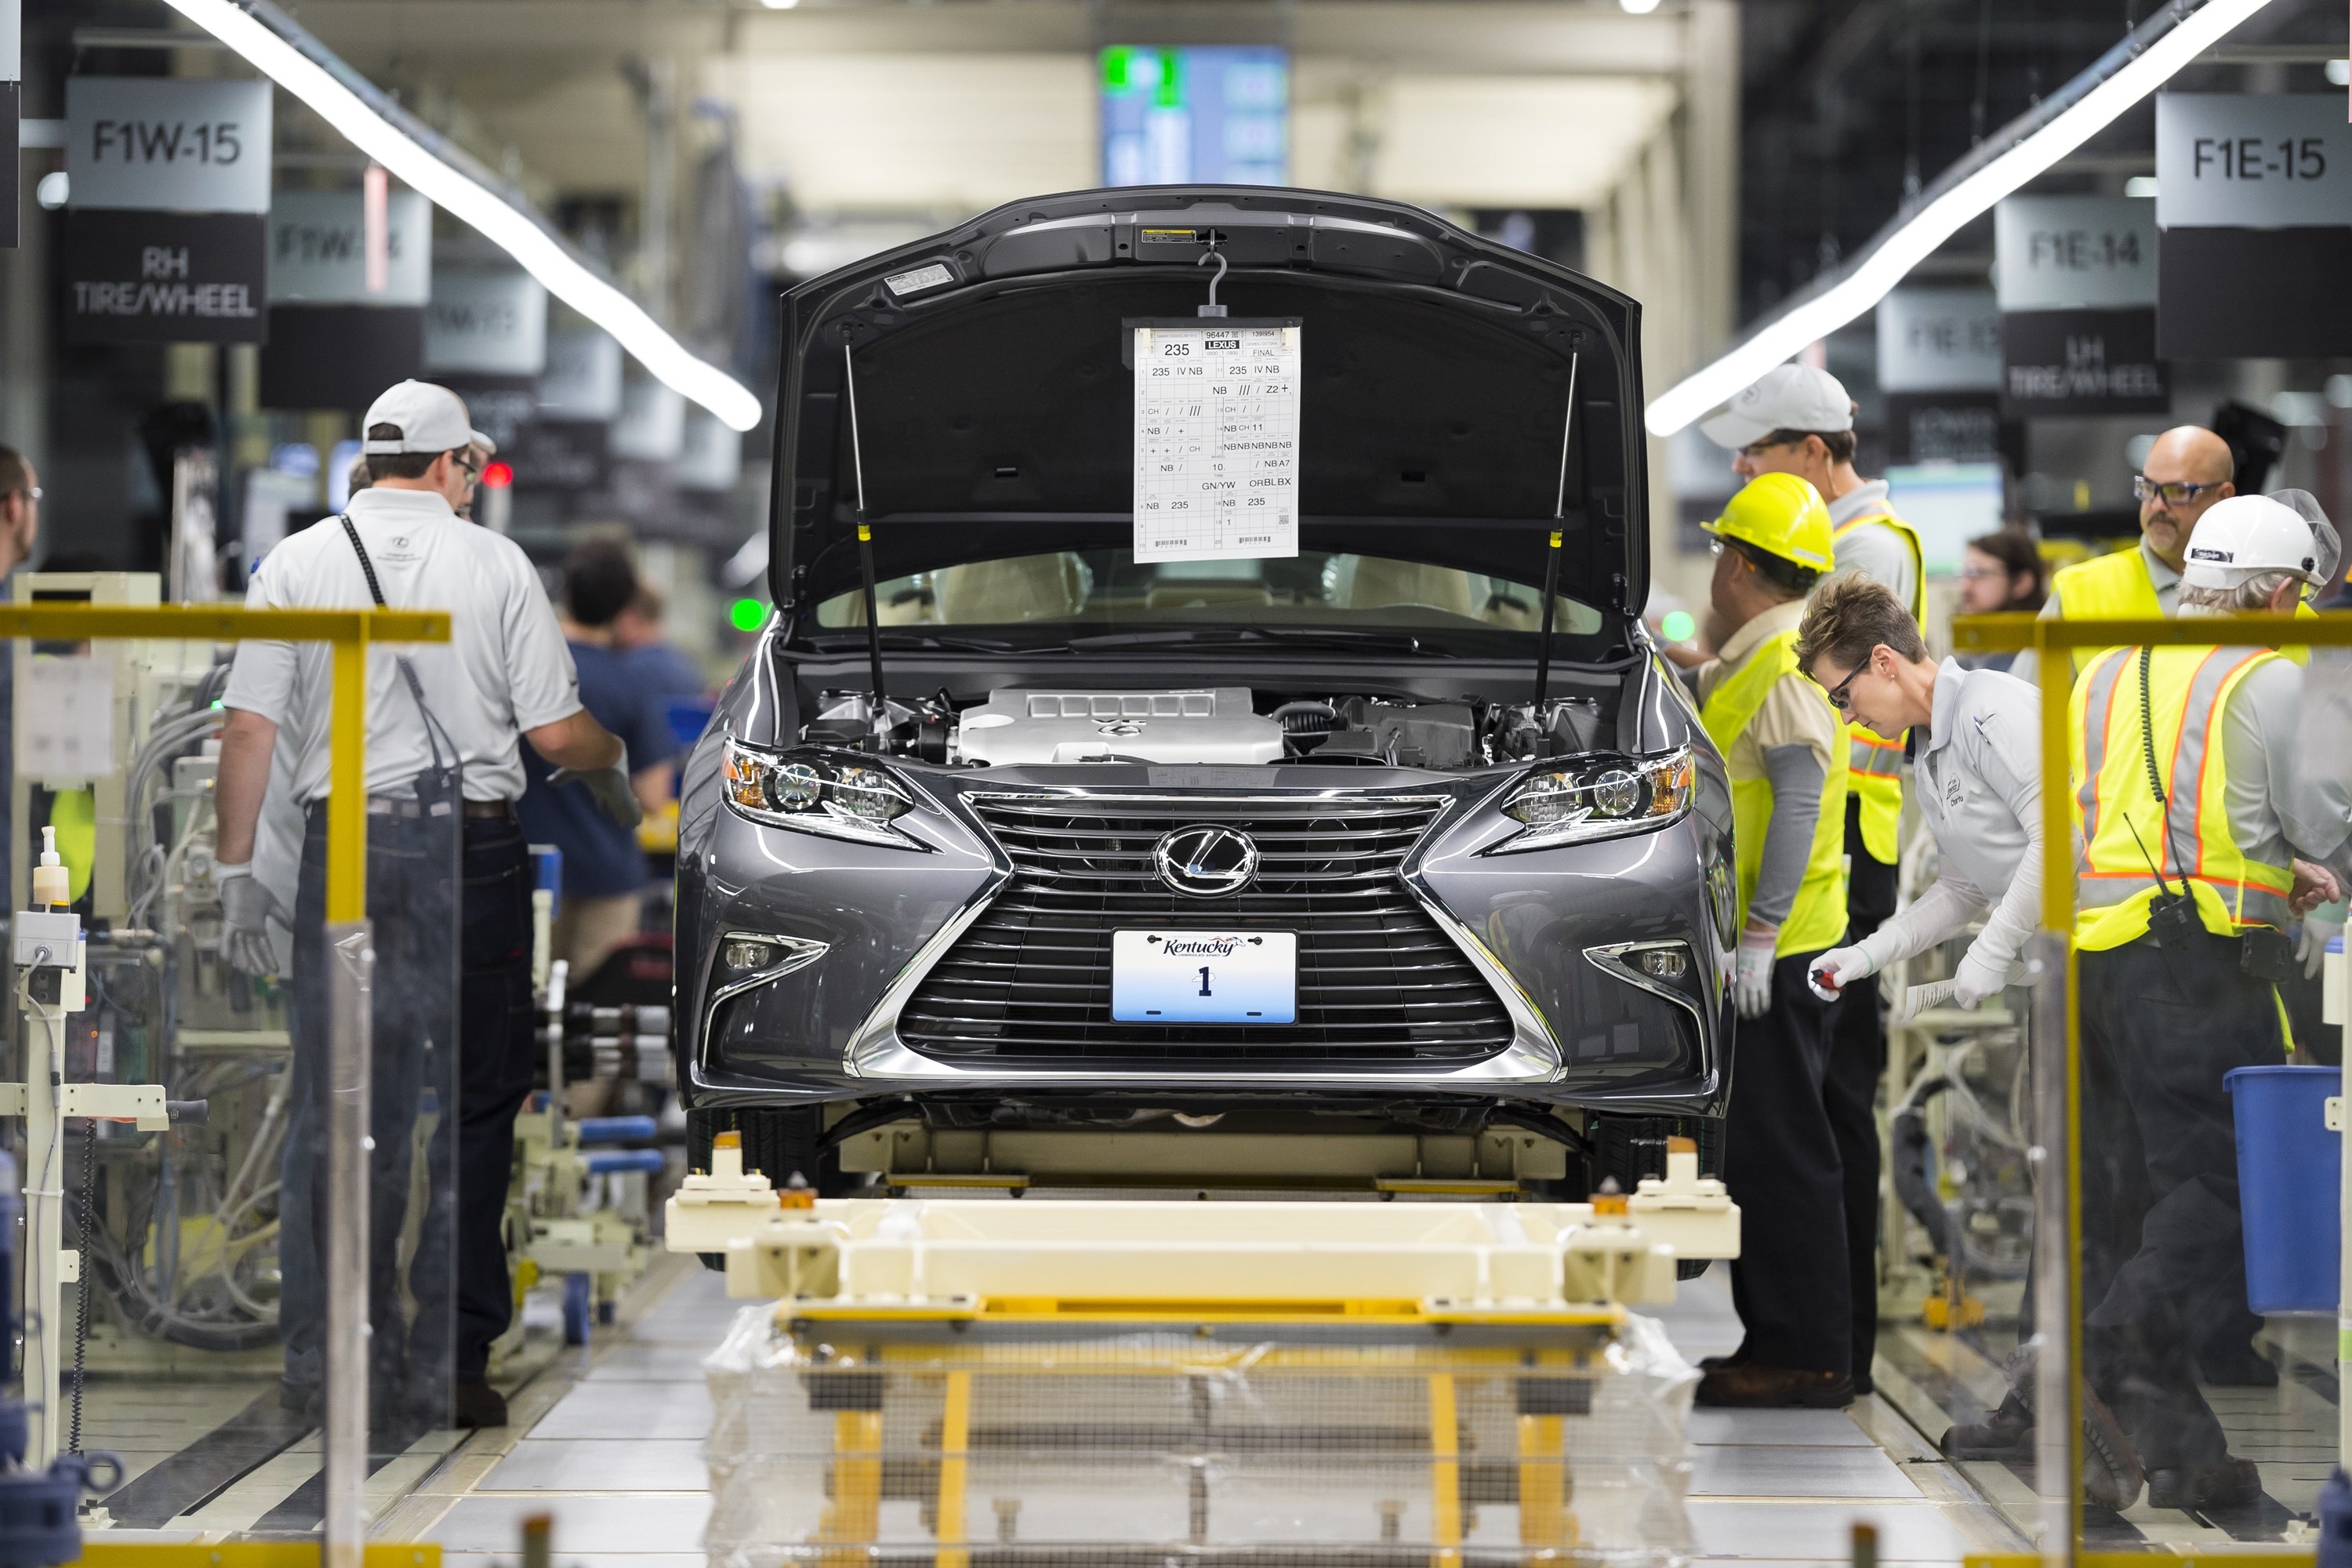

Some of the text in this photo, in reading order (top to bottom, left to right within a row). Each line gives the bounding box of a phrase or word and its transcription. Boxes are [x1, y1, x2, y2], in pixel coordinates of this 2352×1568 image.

[93, 120, 242, 165] F1W-15
[2194, 137, 2325, 180] F1E-15
[2028, 230, 2140, 270] F1E-14
[142, 246, 188, 279] RH
[74, 281, 256, 318] TIRE/WHEEL
[1164, 343, 1189, 356] 235
[1152, 368, 1170, 376] 235
[1229, 366, 1247, 375] 235
[1202, 481, 1236, 490] GN/YW
[1171, 501, 1189, 510] 235
[1163, 939, 1234, 957] Kentucky
[1199, 966, 1212, 996] 1
